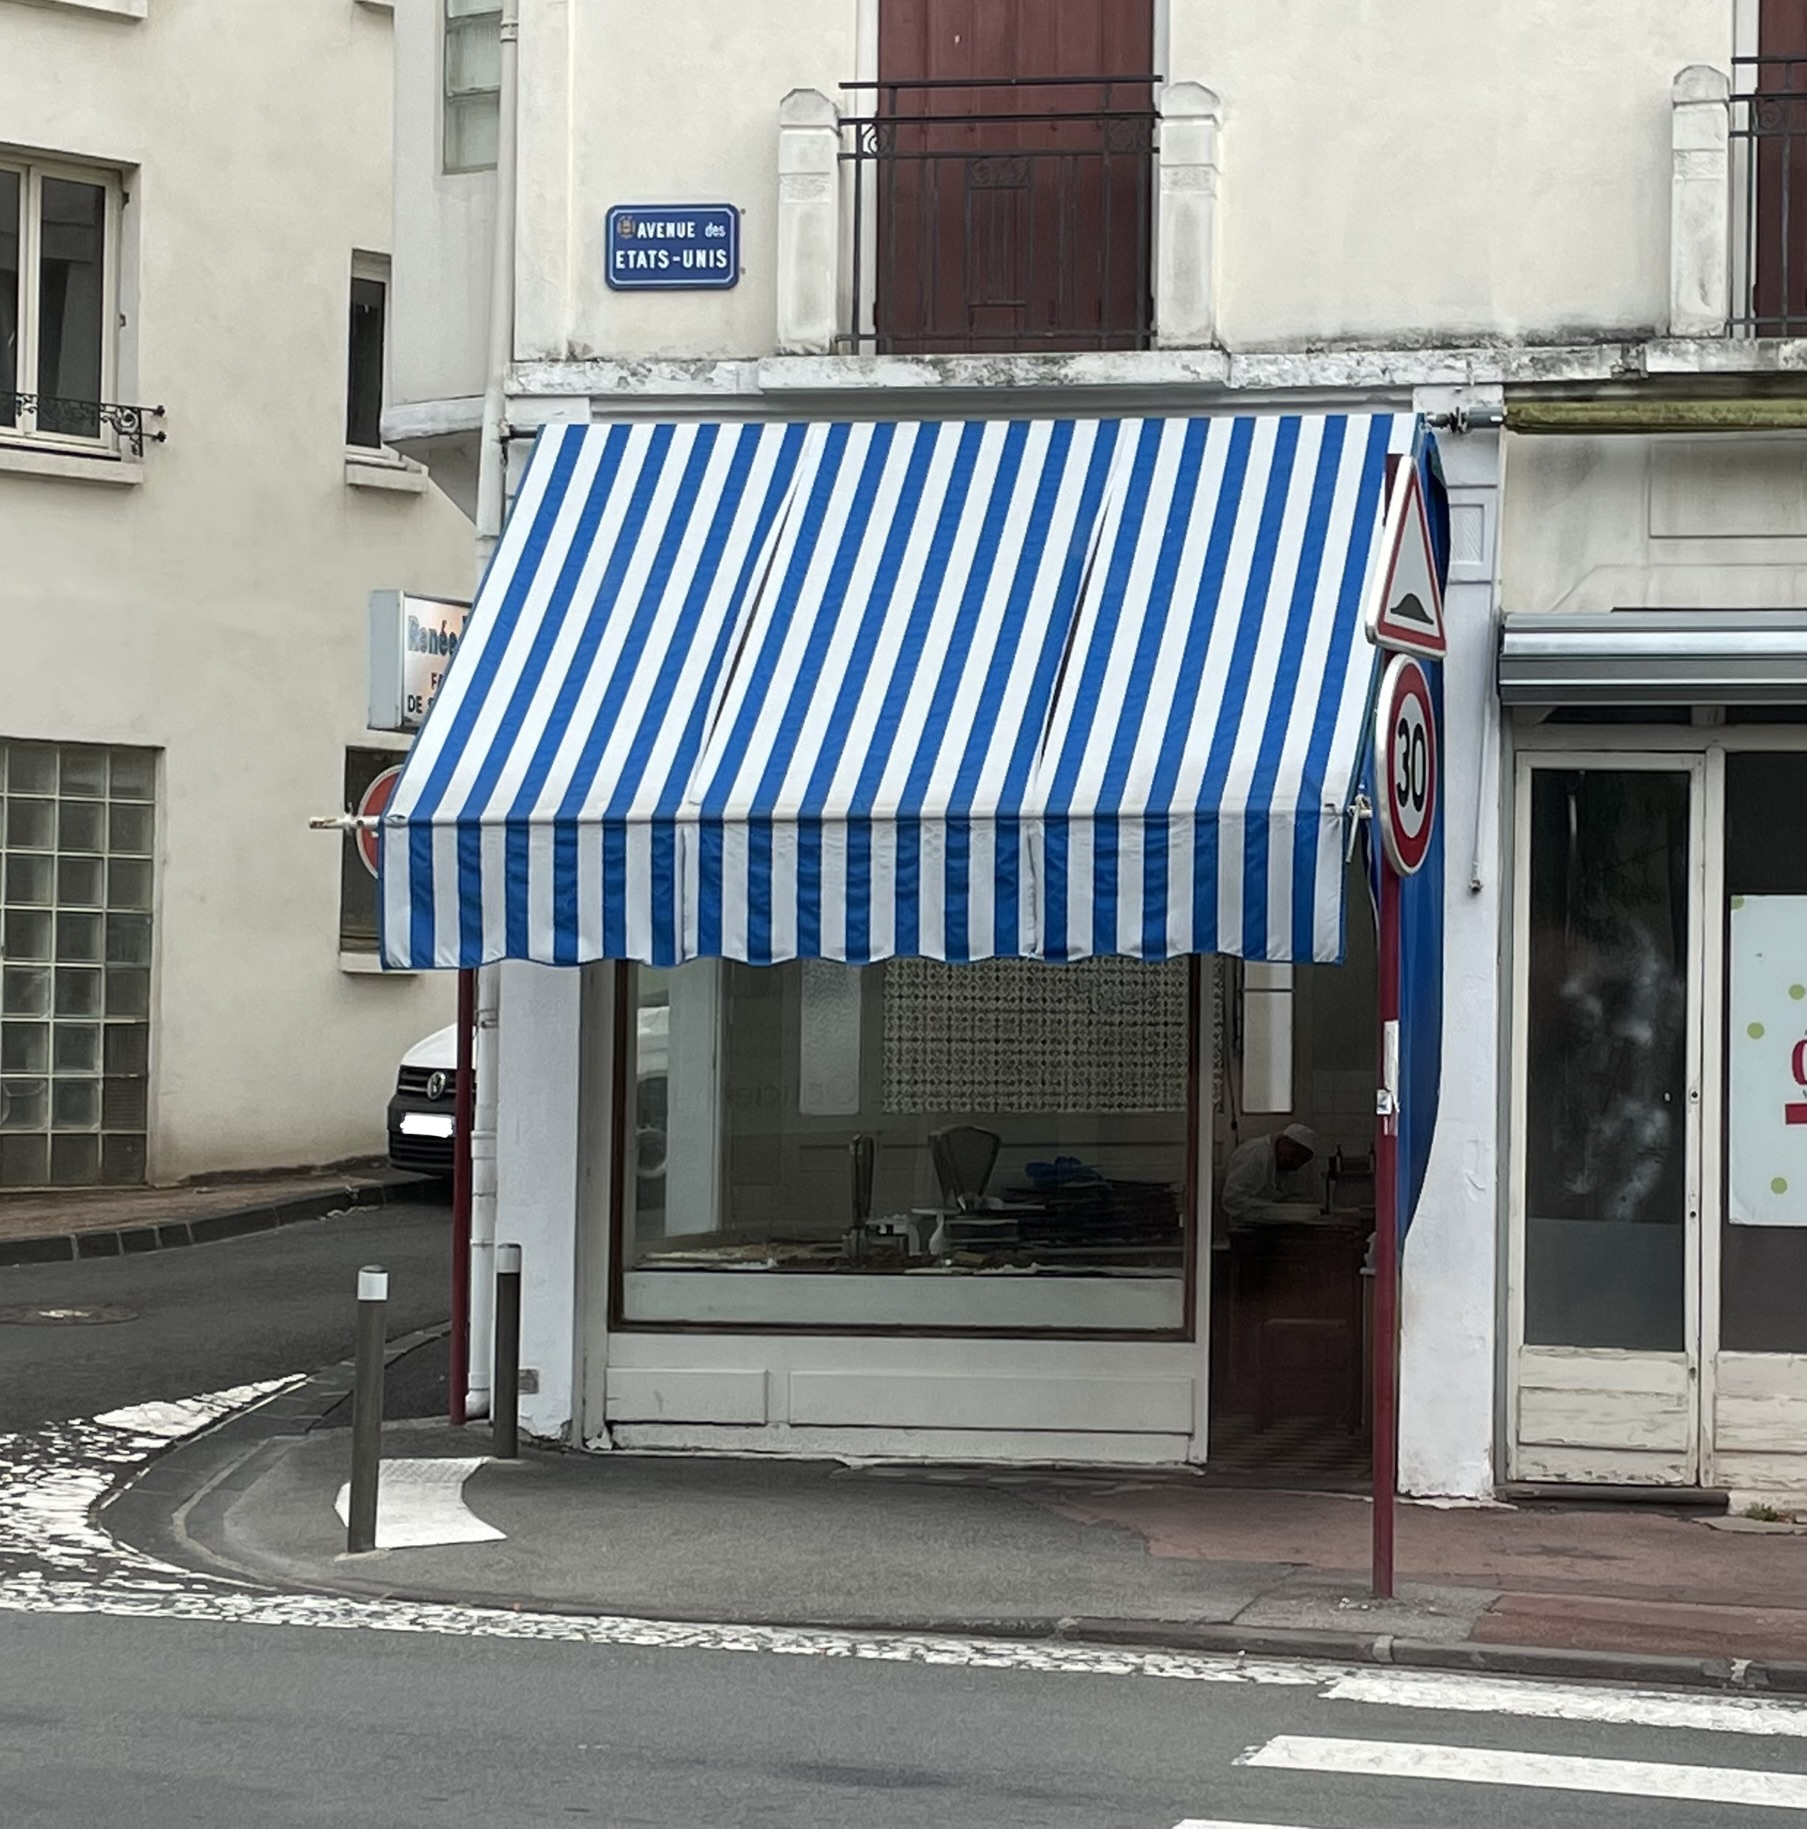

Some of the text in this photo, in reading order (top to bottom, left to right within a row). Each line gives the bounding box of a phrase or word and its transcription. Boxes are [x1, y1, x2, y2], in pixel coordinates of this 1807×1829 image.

[637, 221, 727, 239] AVENUE des
[615, 248, 728, 270] ETATS-UNIS
[407, 694, 423, 715] DE
[1396, 717, 1427, 813] 30
